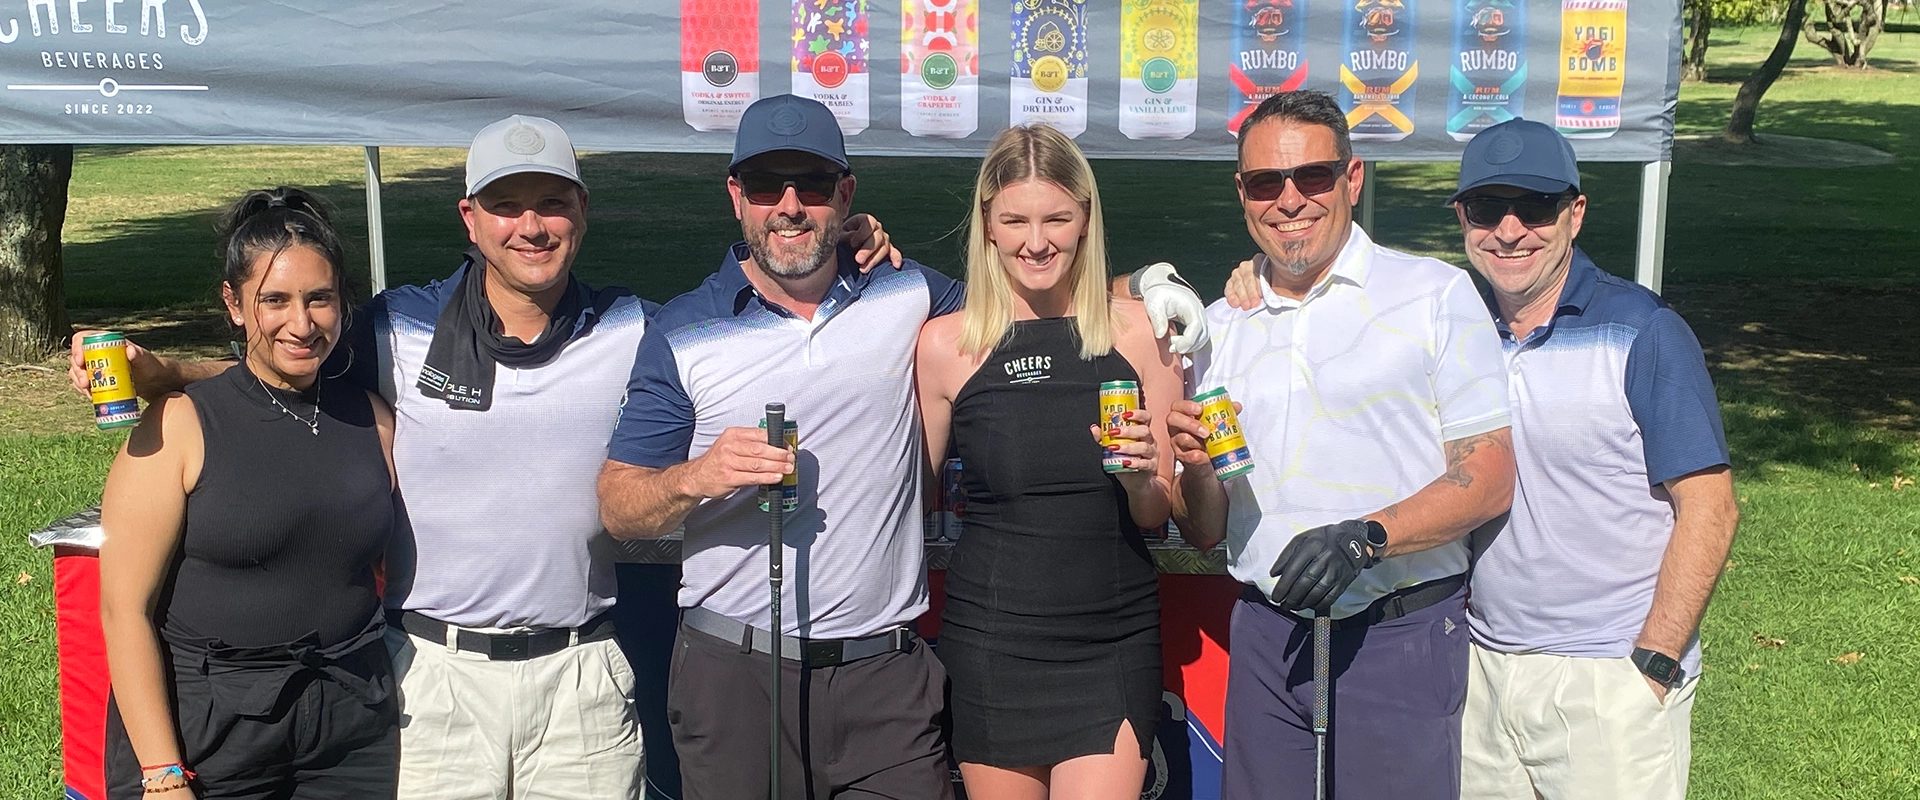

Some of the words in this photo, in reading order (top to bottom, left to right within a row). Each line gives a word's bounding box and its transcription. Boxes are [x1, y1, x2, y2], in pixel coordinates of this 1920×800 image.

[41, 51, 164, 70] BEVERAGES
[1240, 49, 1297, 71] RUMBO
[1350, 49, 1407, 71] RUMBO
[1460, 49, 1517, 72] RUMBO
[1568, 57, 1617, 71] BOMB
[820, 65, 840, 73] B&T
[930, 67, 950, 75] B&T
[1366, 86, 1390, 94] RUM
[1475, 86, 1500, 94] RUM
[1035, 96, 1052, 104] GIN
[64, 103, 109, 115] SINCE
[117, 103, 153, 115] 2022
[1043, 105, 1075, 113] LEMON
[1129, 105, 1165, 114] VANILLA
[1167, 105, 1187, 113] LIME
[1004, 356, 1052, 375] CHEERS
[89, 376, 116, 388] OMB
[471, 387, 482, 397] H
[1208, 425, 1238, 441] BOMB
